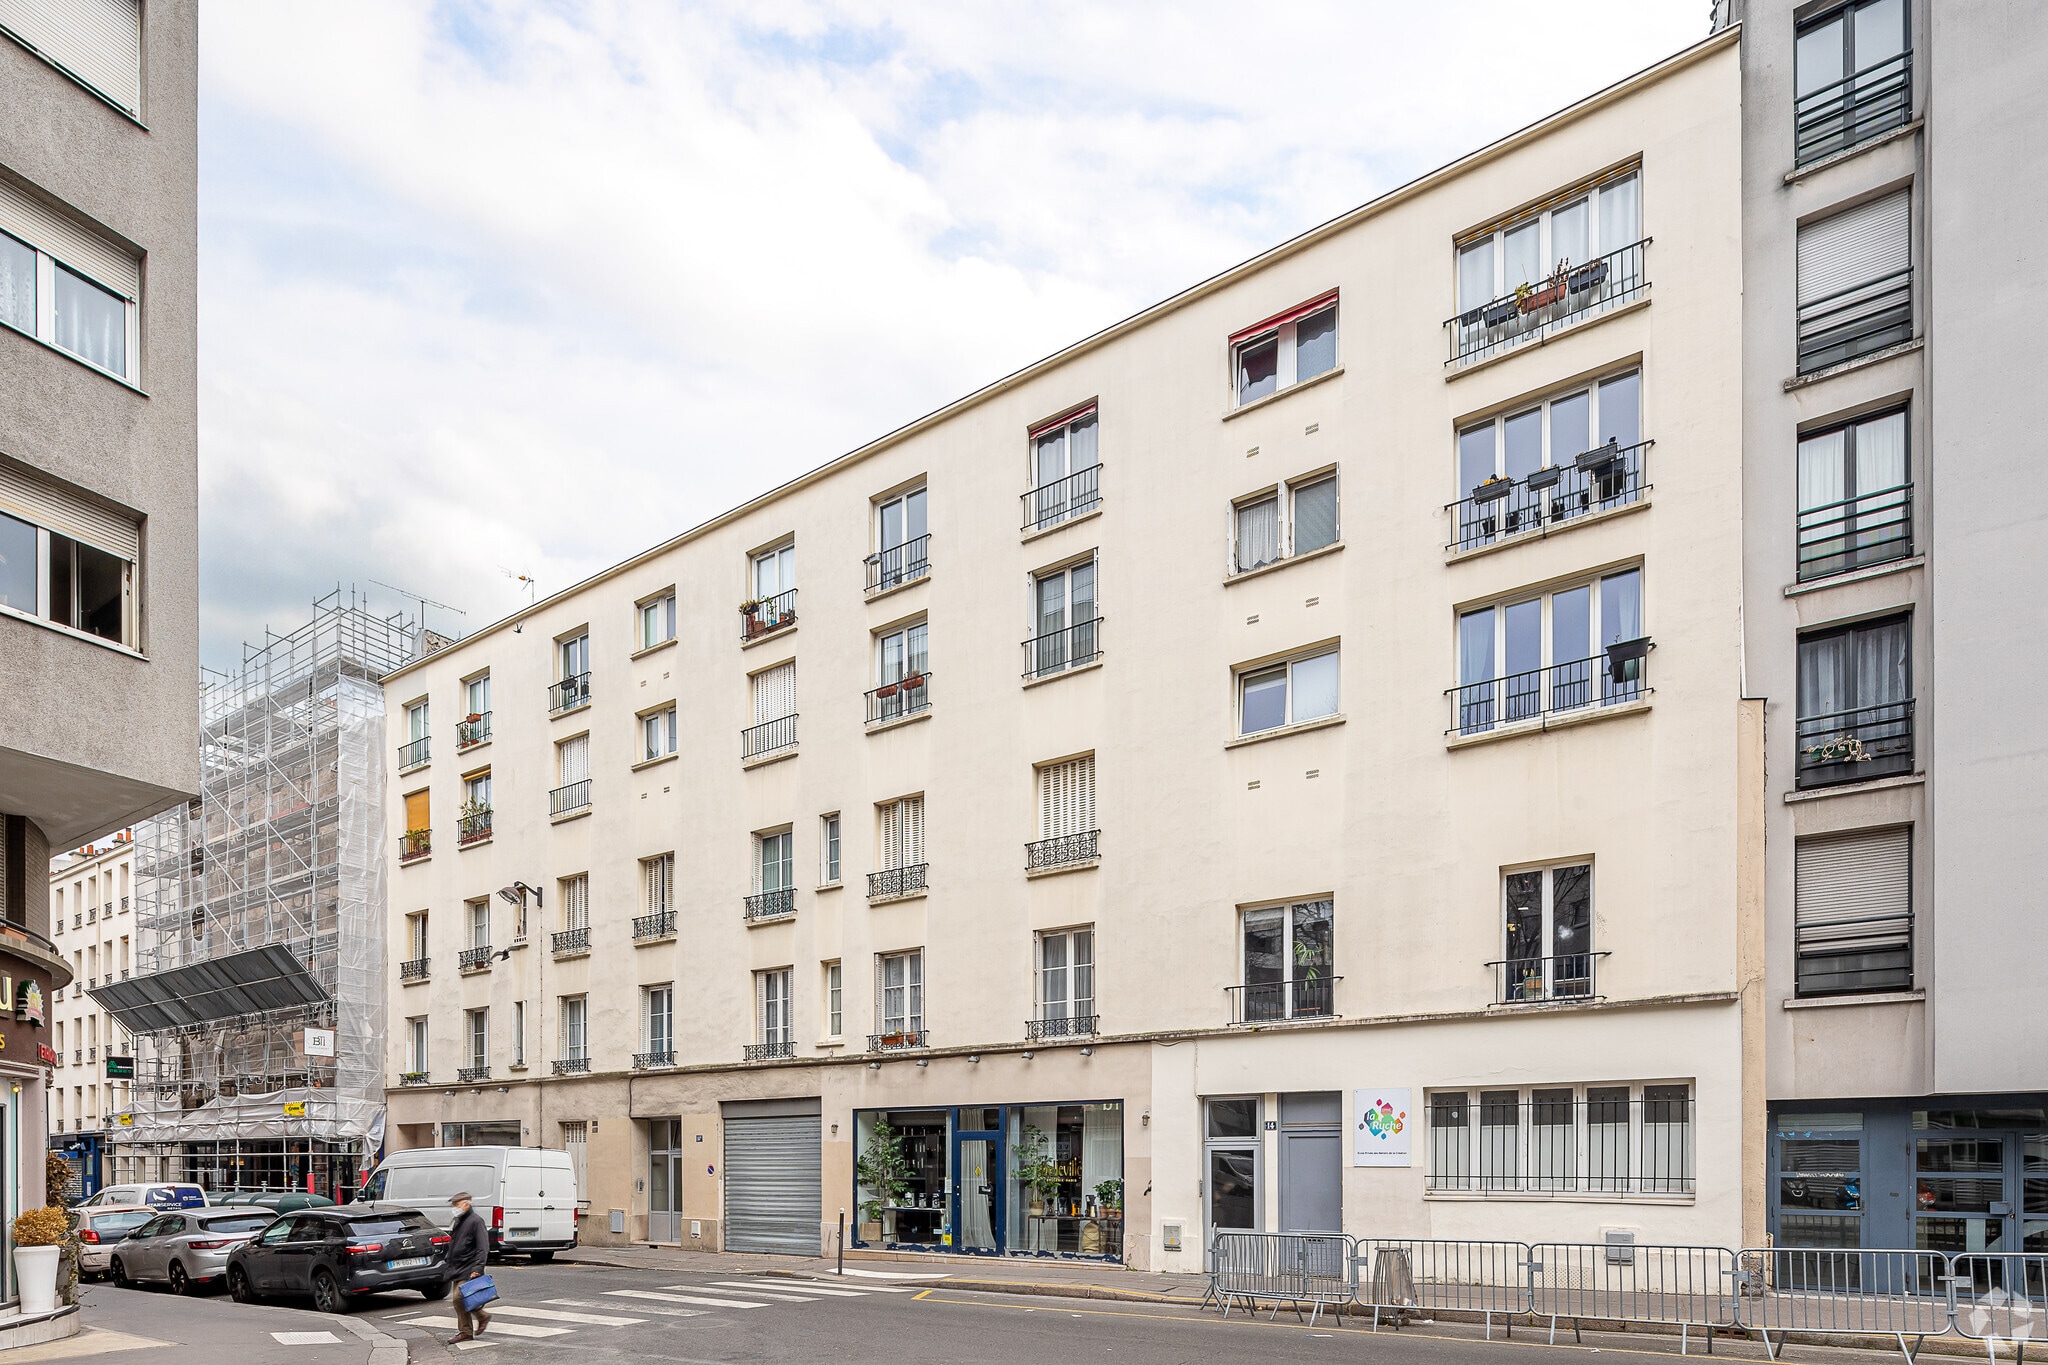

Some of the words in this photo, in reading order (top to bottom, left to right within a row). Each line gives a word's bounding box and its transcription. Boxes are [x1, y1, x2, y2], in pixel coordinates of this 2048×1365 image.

[1367, 1112, 1376, 1120] la
[1267, 1122, 1275, 1130] 14
[1372, 1121, 1402, 1130] Ruche
